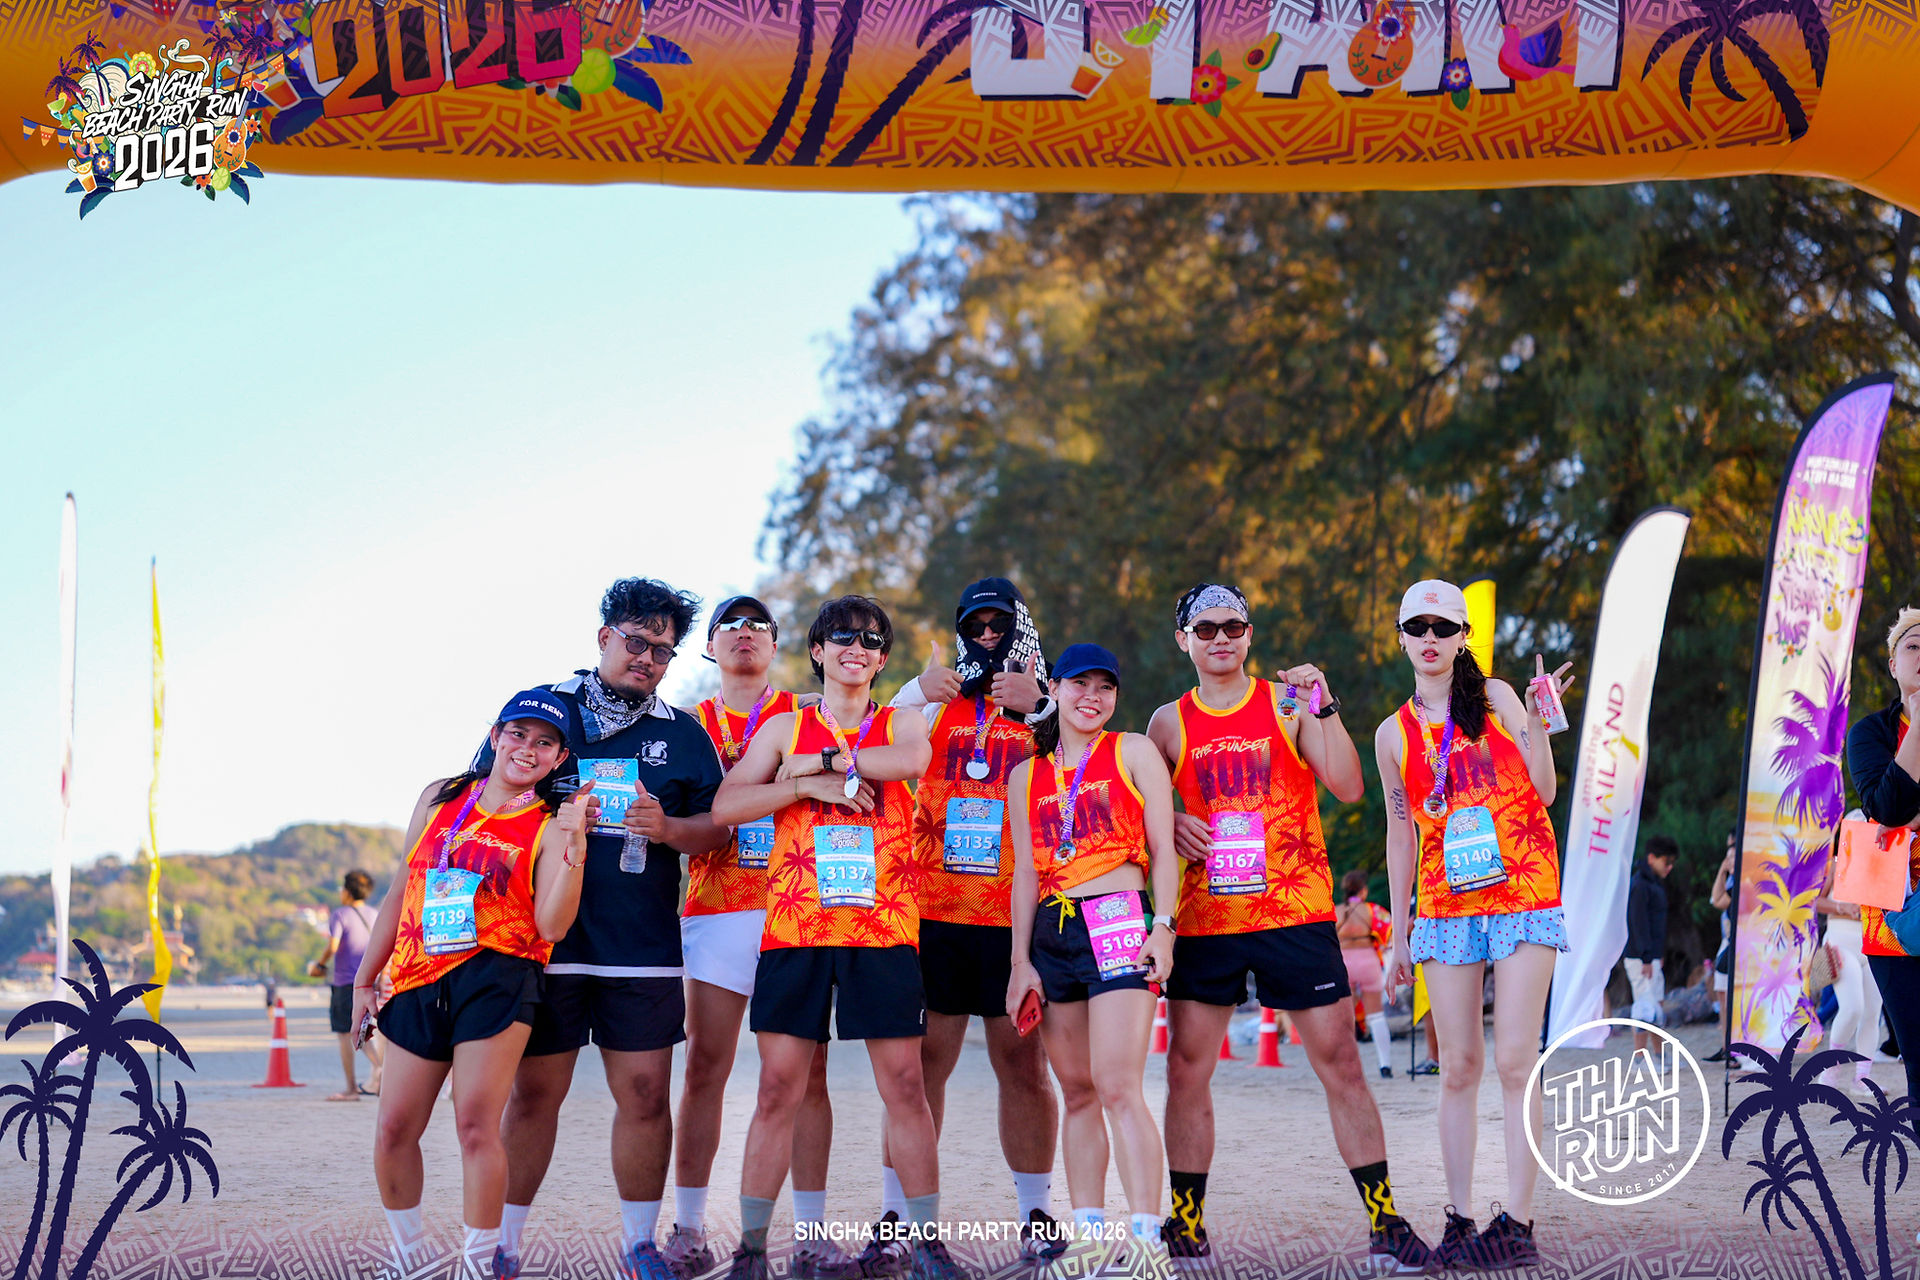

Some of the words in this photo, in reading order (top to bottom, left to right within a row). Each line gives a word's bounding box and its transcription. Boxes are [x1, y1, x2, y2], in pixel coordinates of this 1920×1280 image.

[519, 700, 539, 708] FOR
[541, 702, 565, 720] RENT
[1214, 736, 1272, 755] SUNSET
[1193, 744, 1271, 805] RUN
[1582, 724, 1603, 808] amazing
[1588, 683, 1625, 858] THAILAND
[590, 793, 630, 810] 141
[747, 831, 775, 845] 313
[952, 835, 993, 850] 3135
[1214, 853, 1257, 869] 5167
[1451, 847, 1493, 869] 3140
[826, 866, 868, 881] 3137
[428, 908, 466, 927] 3139
[1102, 932, 1143, 953] 5168
